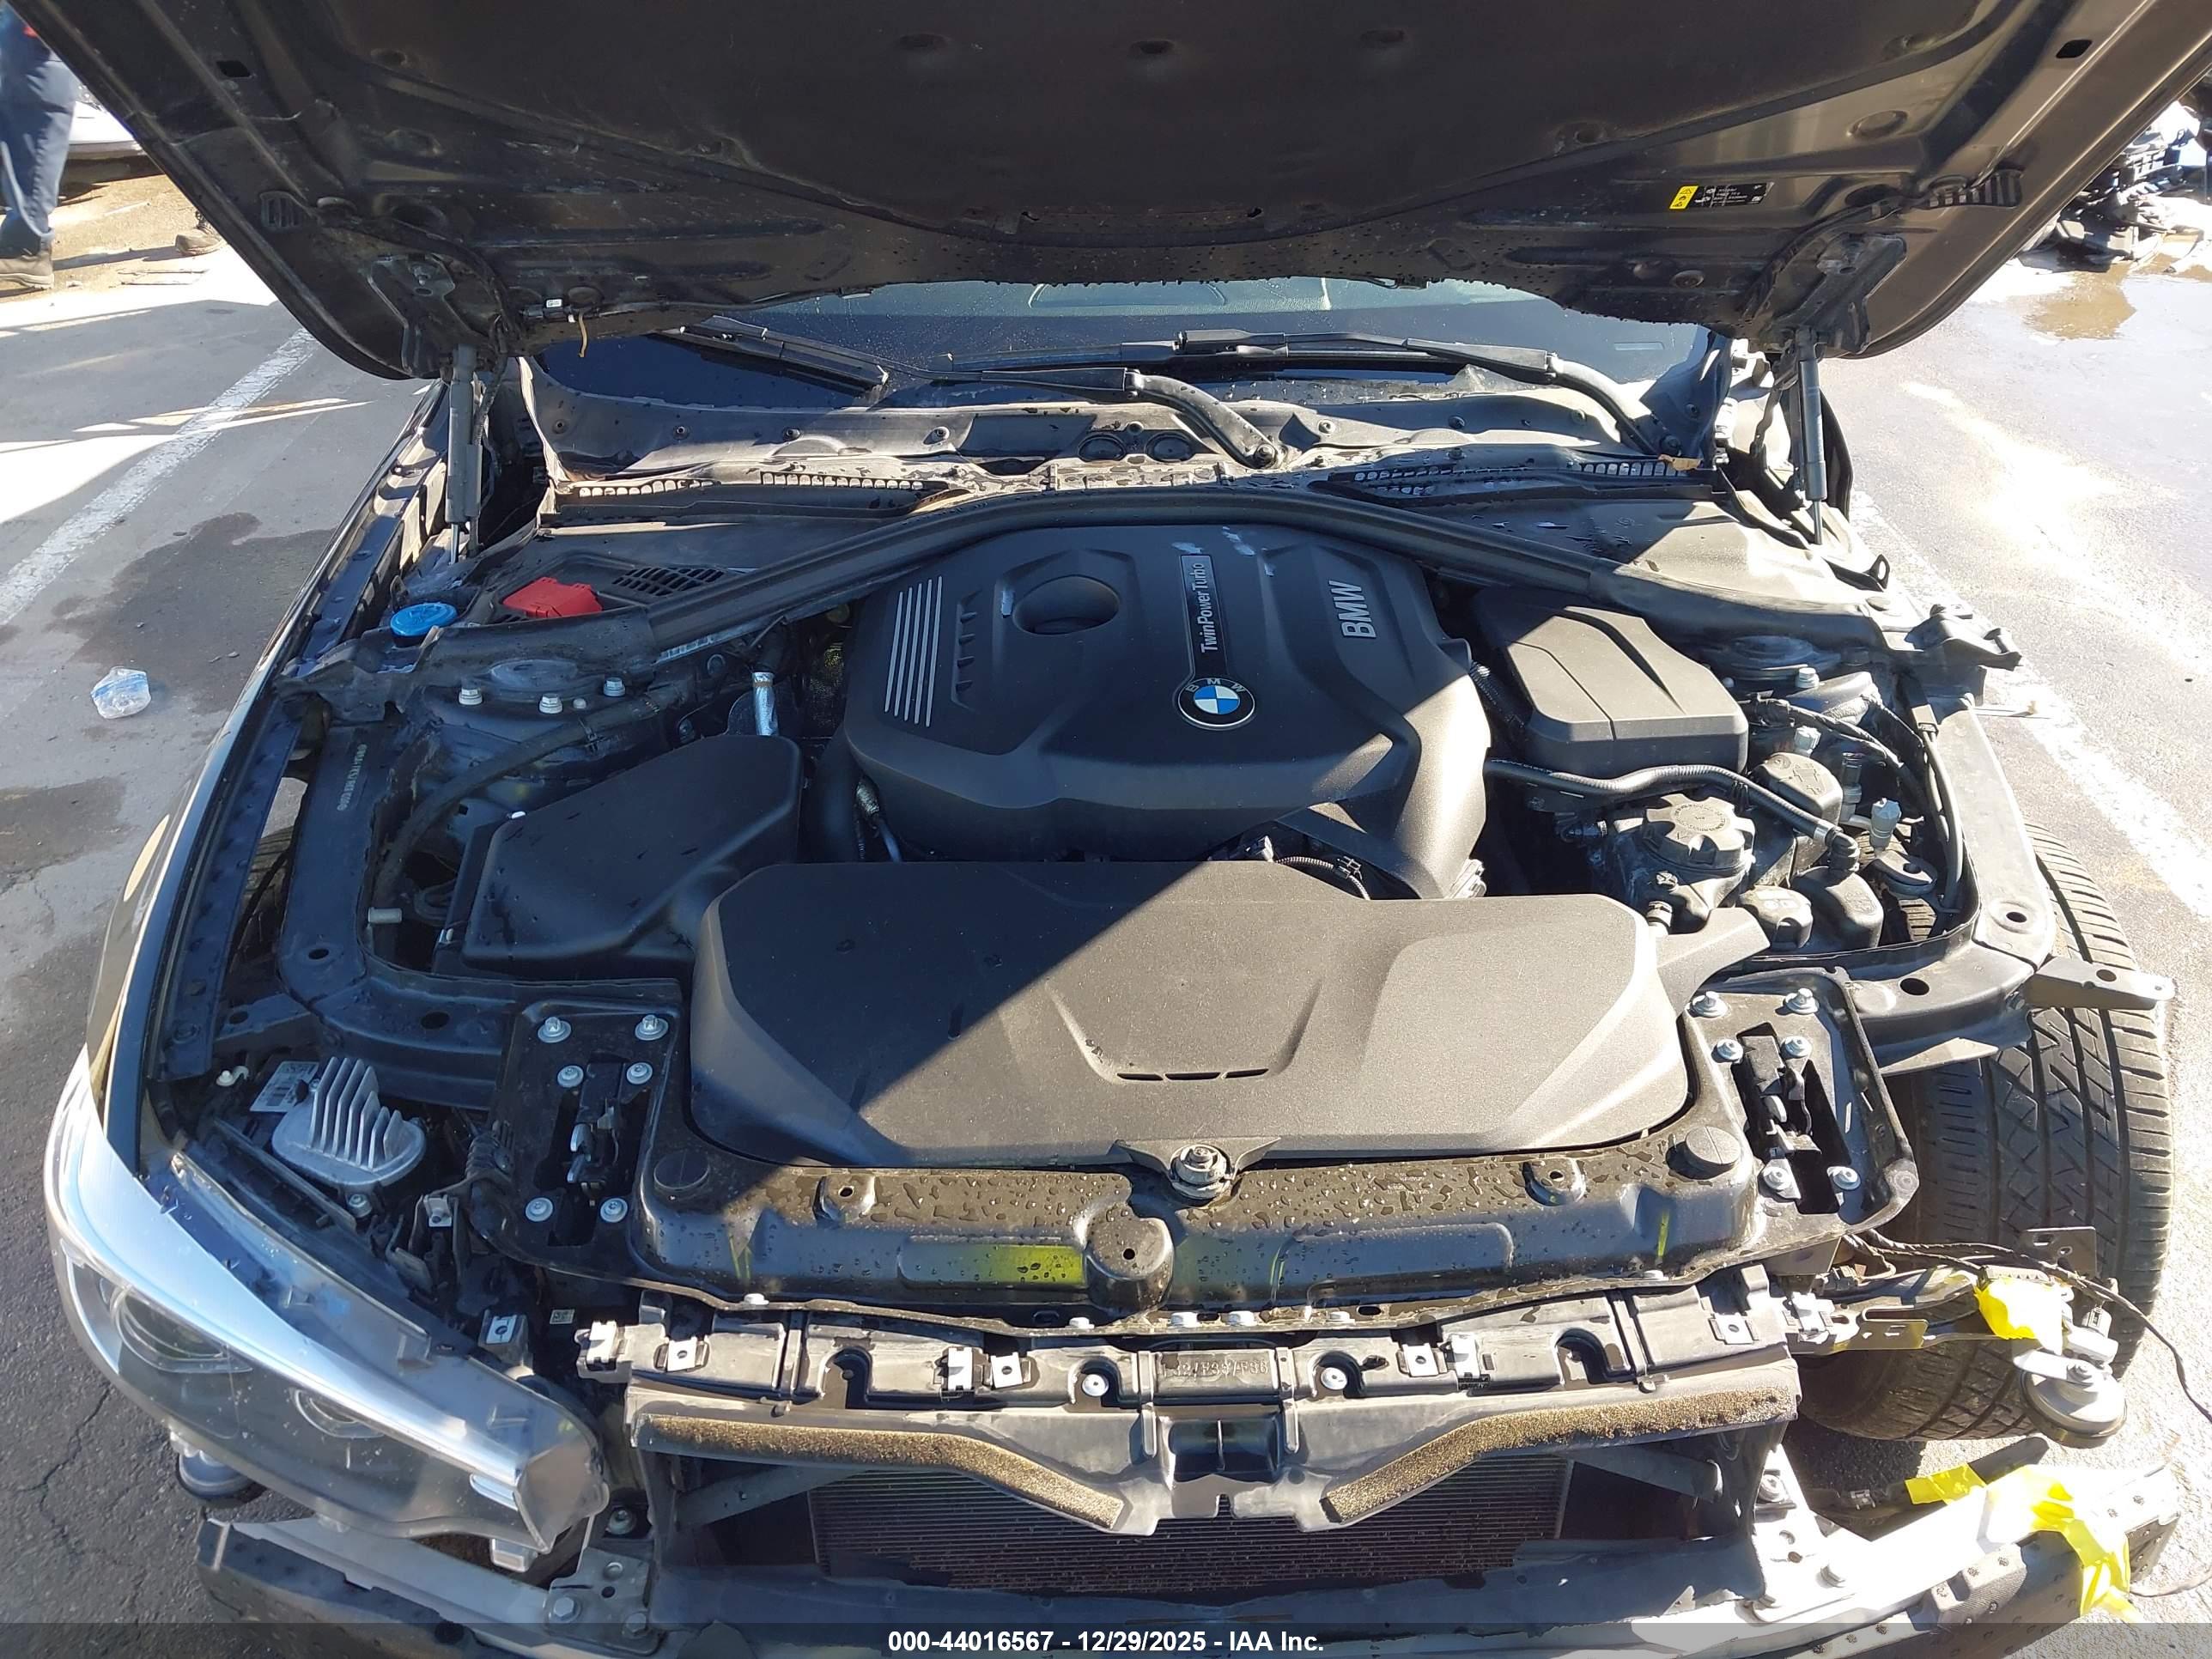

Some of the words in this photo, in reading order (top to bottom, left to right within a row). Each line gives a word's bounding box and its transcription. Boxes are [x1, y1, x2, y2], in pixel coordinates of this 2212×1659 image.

[1189, 563, 1209, 591] Turbo
[1196, 591, 1218, 653] TwinPower
[1328, 580, 1376, 638] BMW
[1185, 678, 1246, 693] BMW
